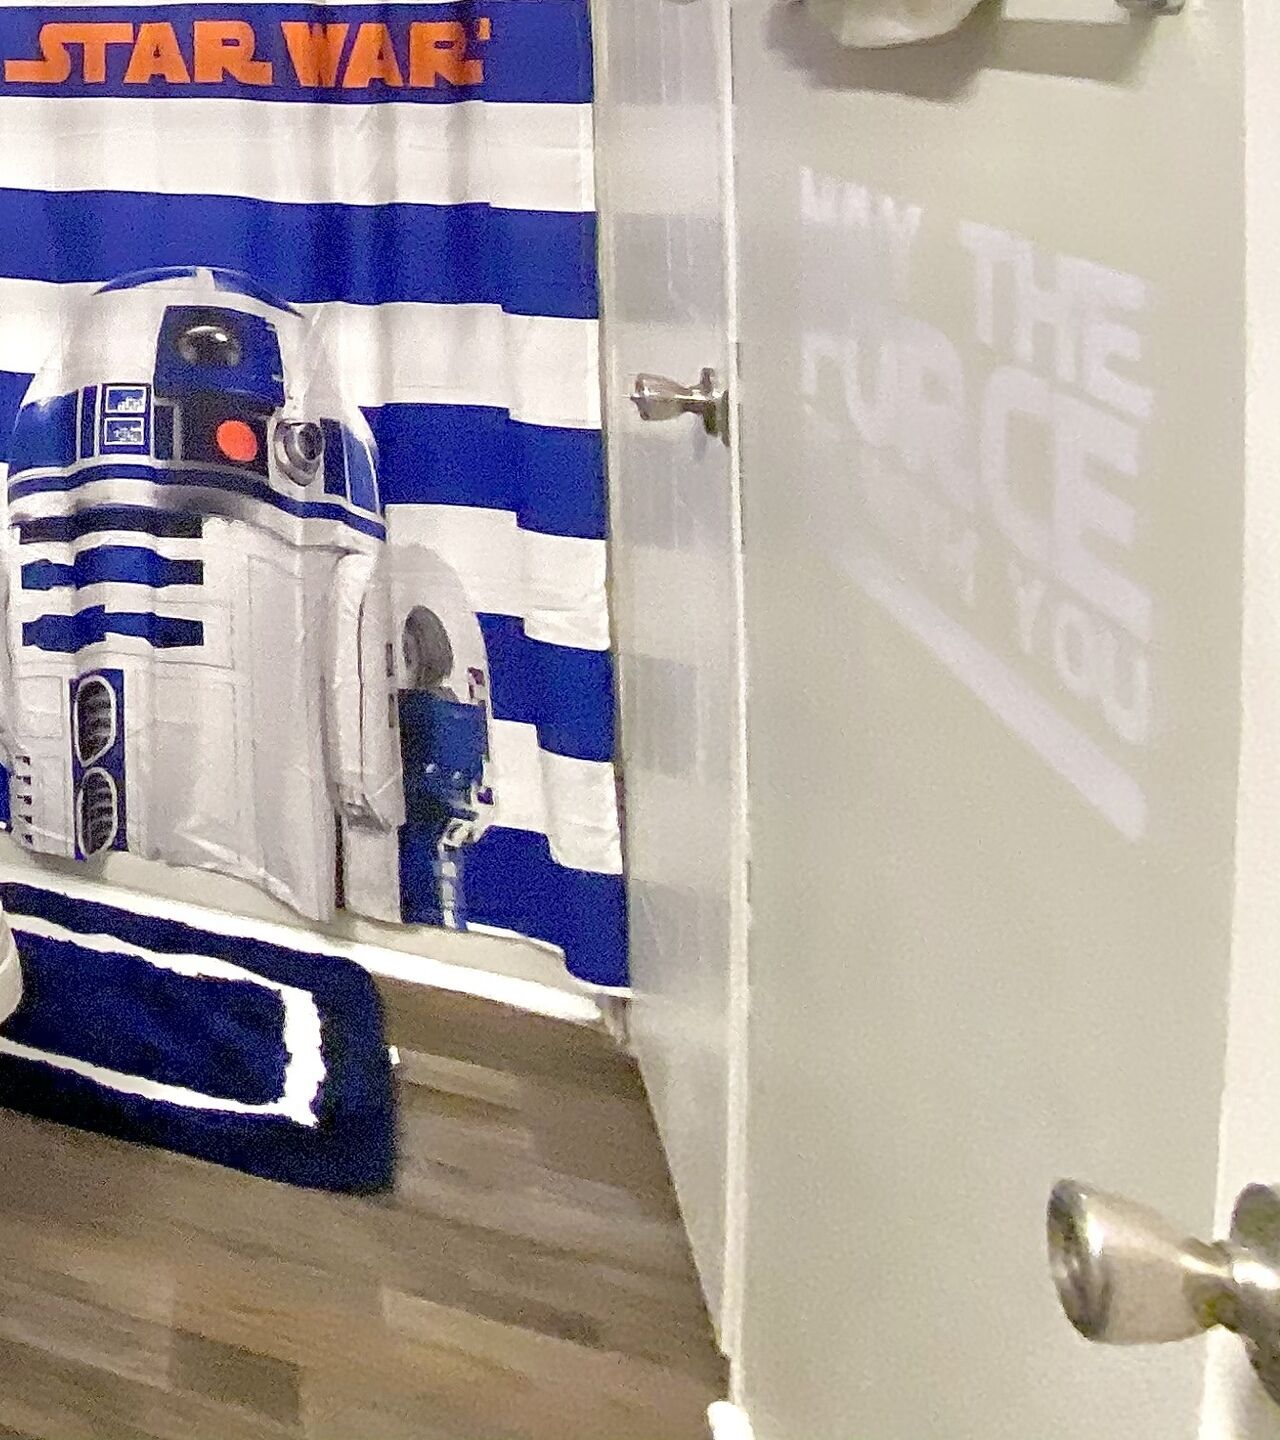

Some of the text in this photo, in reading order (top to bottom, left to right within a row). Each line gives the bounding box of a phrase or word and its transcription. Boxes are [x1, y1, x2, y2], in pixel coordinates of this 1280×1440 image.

[4, 16, 491, 88] STAR WAR
[957, 218, 1154, 420] THE
